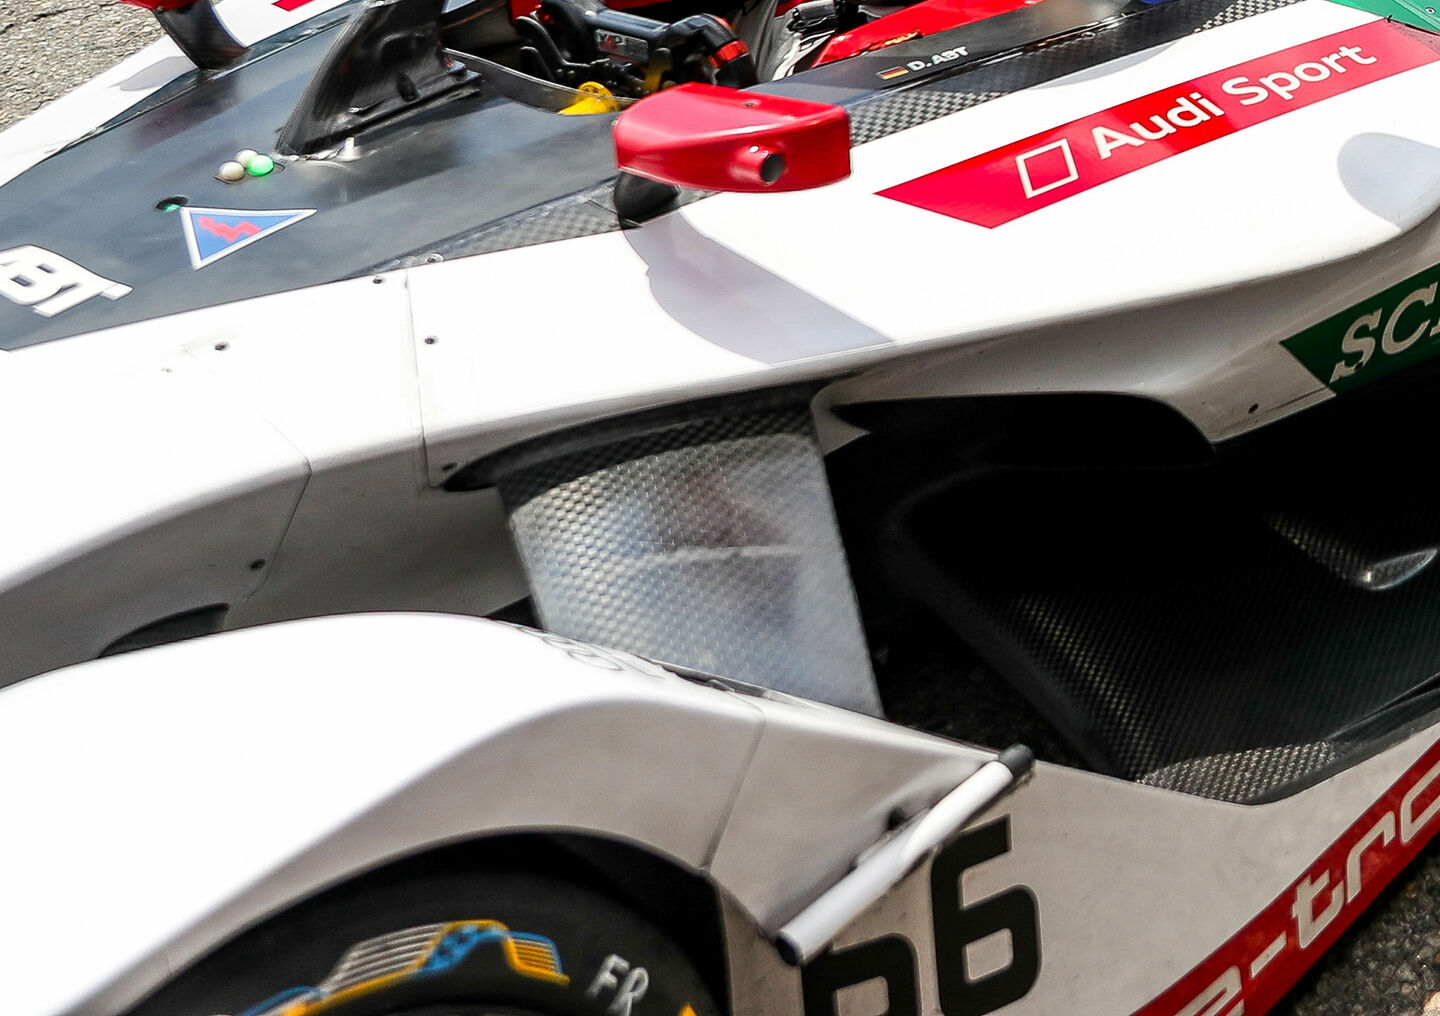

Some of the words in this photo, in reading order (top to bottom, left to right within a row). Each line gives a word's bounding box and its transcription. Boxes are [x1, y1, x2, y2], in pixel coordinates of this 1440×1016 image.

[1095, 90, 1226, 160] Audi
[1221, 43, 1378, 107] Sport
[0, 243, 134, 318] BT
